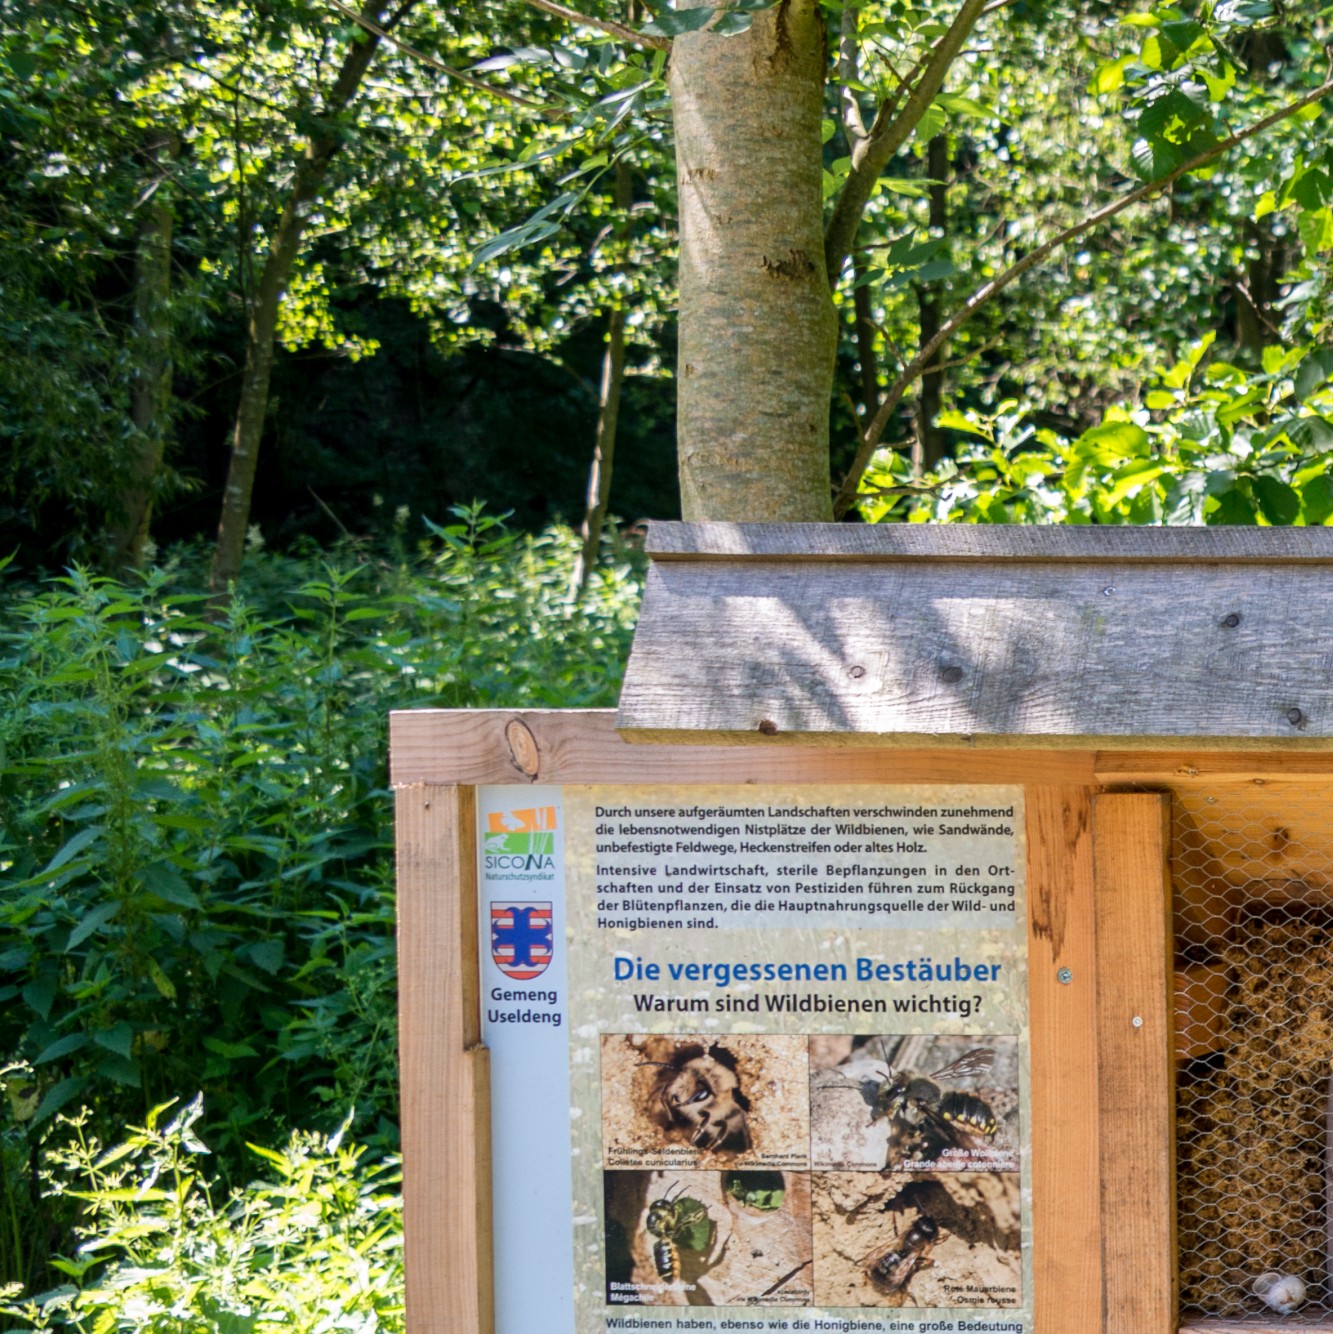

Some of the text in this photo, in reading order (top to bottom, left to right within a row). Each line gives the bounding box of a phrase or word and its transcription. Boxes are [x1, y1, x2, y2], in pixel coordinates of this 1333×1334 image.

[594, 806, 1014, 820] Durch unsere aufgeräumten Landschaften verschwinden zunehmend
[595, 824, 1014, 838] die lebensnotwendigen Nistplätze der Wildbienen, wie Sandwände,
[596, 841, 927, 855] unbefestigte Feldwege, Heckenstreifen oder altes Holz.
[485, 854, 555, 871] SICONA
[485, 872, 555, 882] Naturschutzsyndikat
[597, 917, 719, 931] Honigbienen sind.
[613, 957, 1002, 987] Die vergessenen Bestäuber
[490, 987, 557, 1004] Gemeng
[633, 993, 983, 1017] Warum sind Wildbienen wichtig?
[488, 1009, 562, 1027] Useldeng
[606, 1318, 1024, 1334] Wildbienen haben, ebenso wie die Honigbiene, eine große Bedeutung
